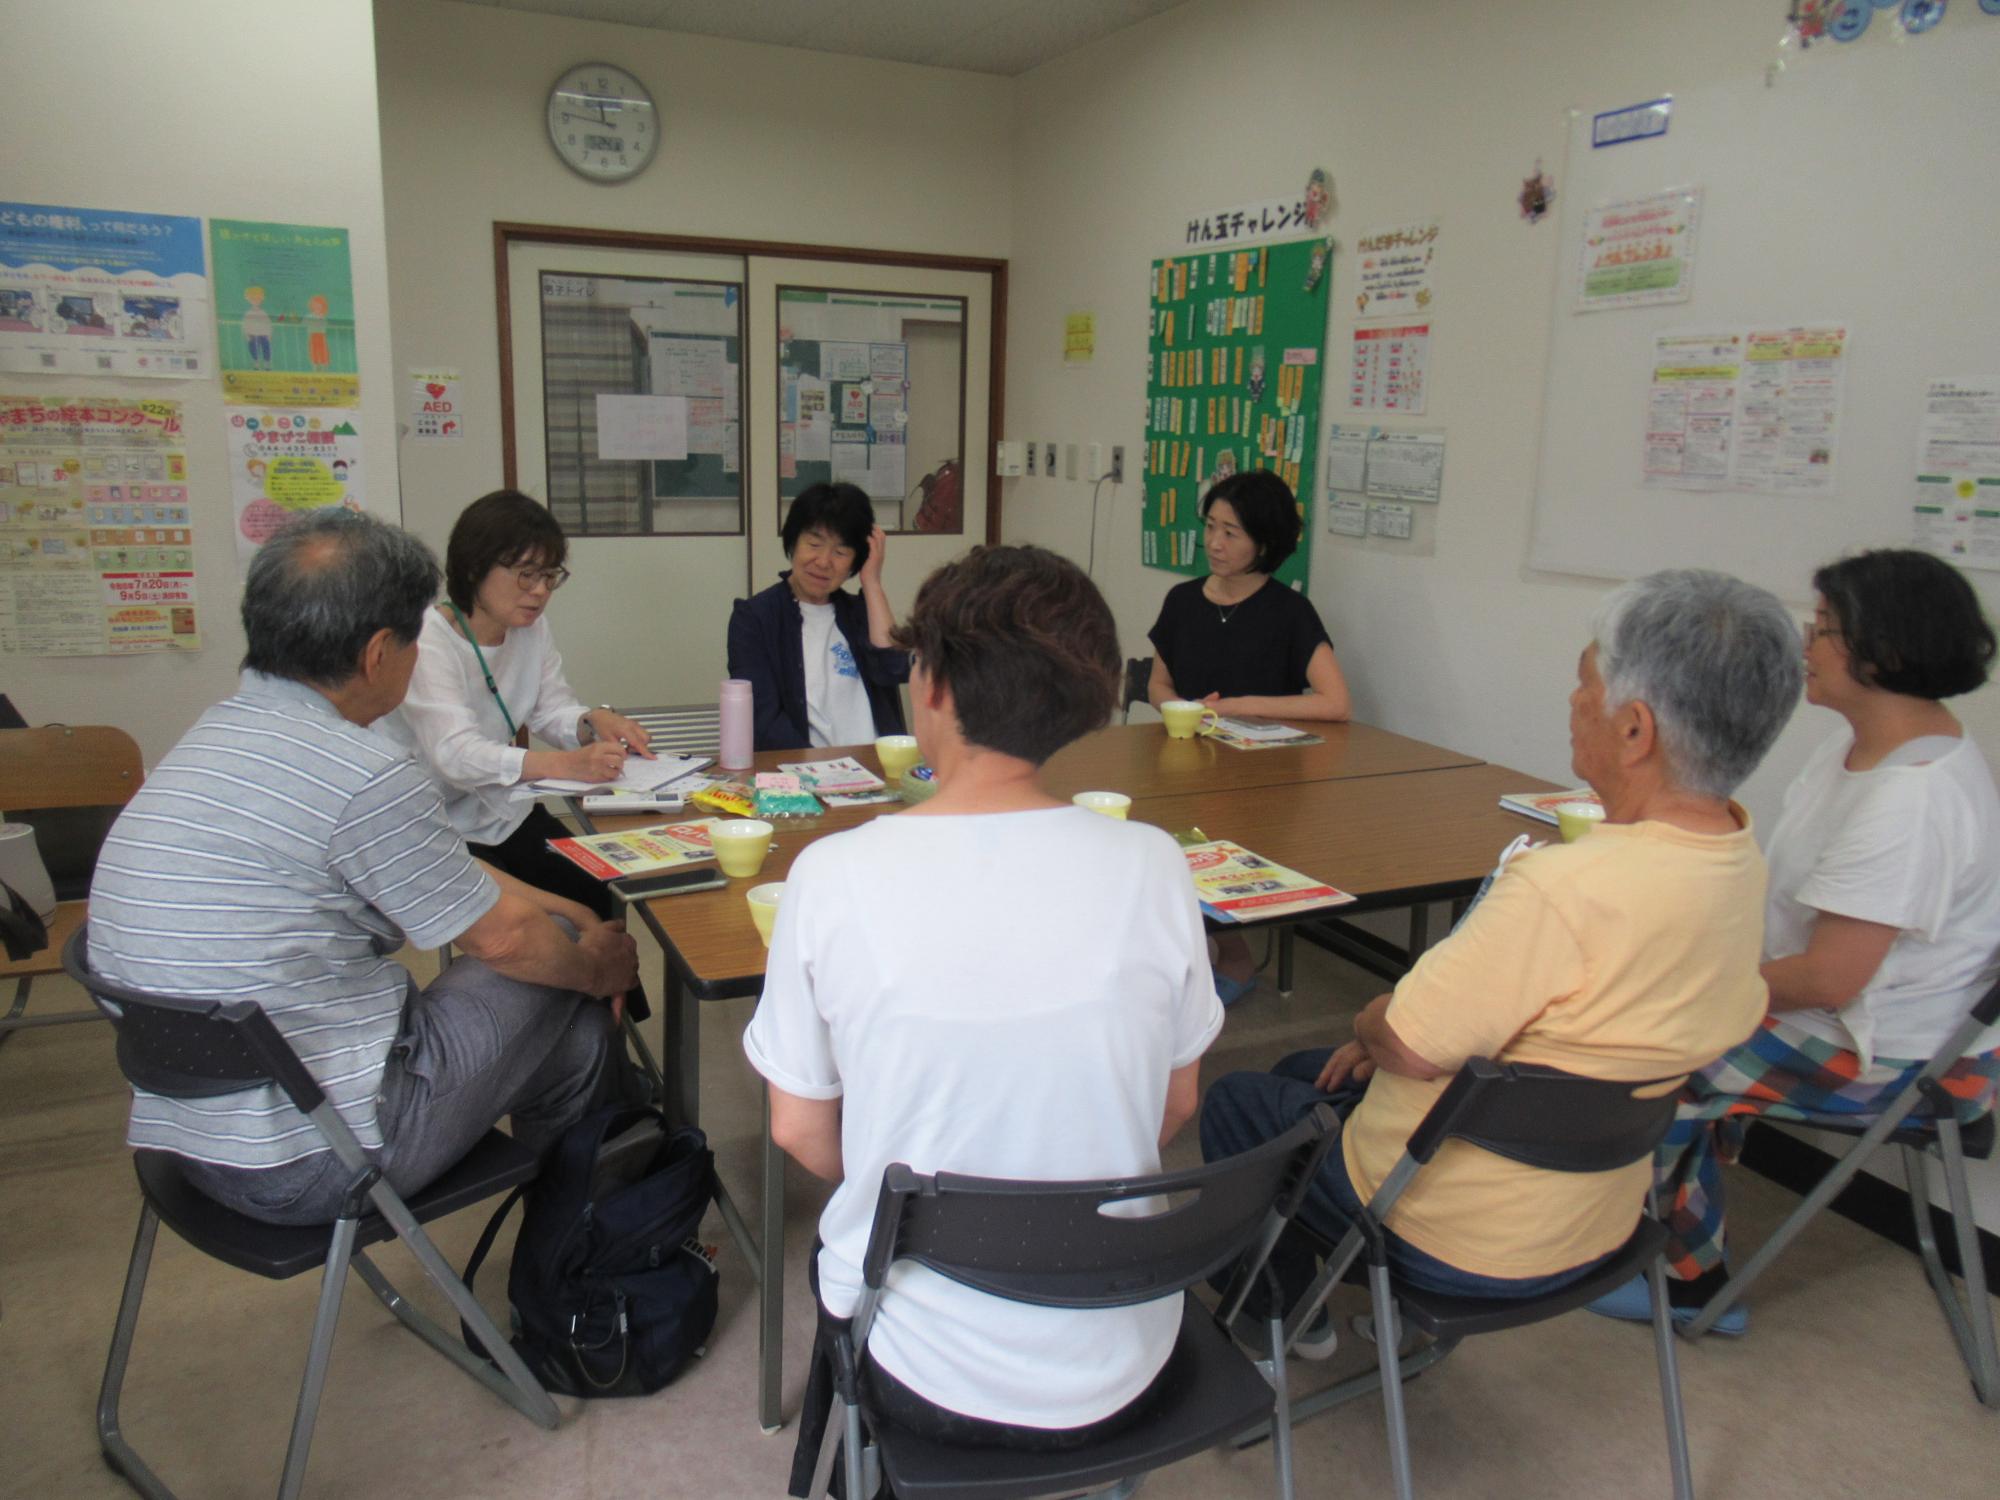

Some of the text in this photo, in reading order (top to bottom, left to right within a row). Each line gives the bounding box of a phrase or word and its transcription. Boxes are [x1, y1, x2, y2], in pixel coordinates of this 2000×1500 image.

[1187, 202, 1306, 243] けん玉チャレンジ
[423, 401, 453, 412] AED
